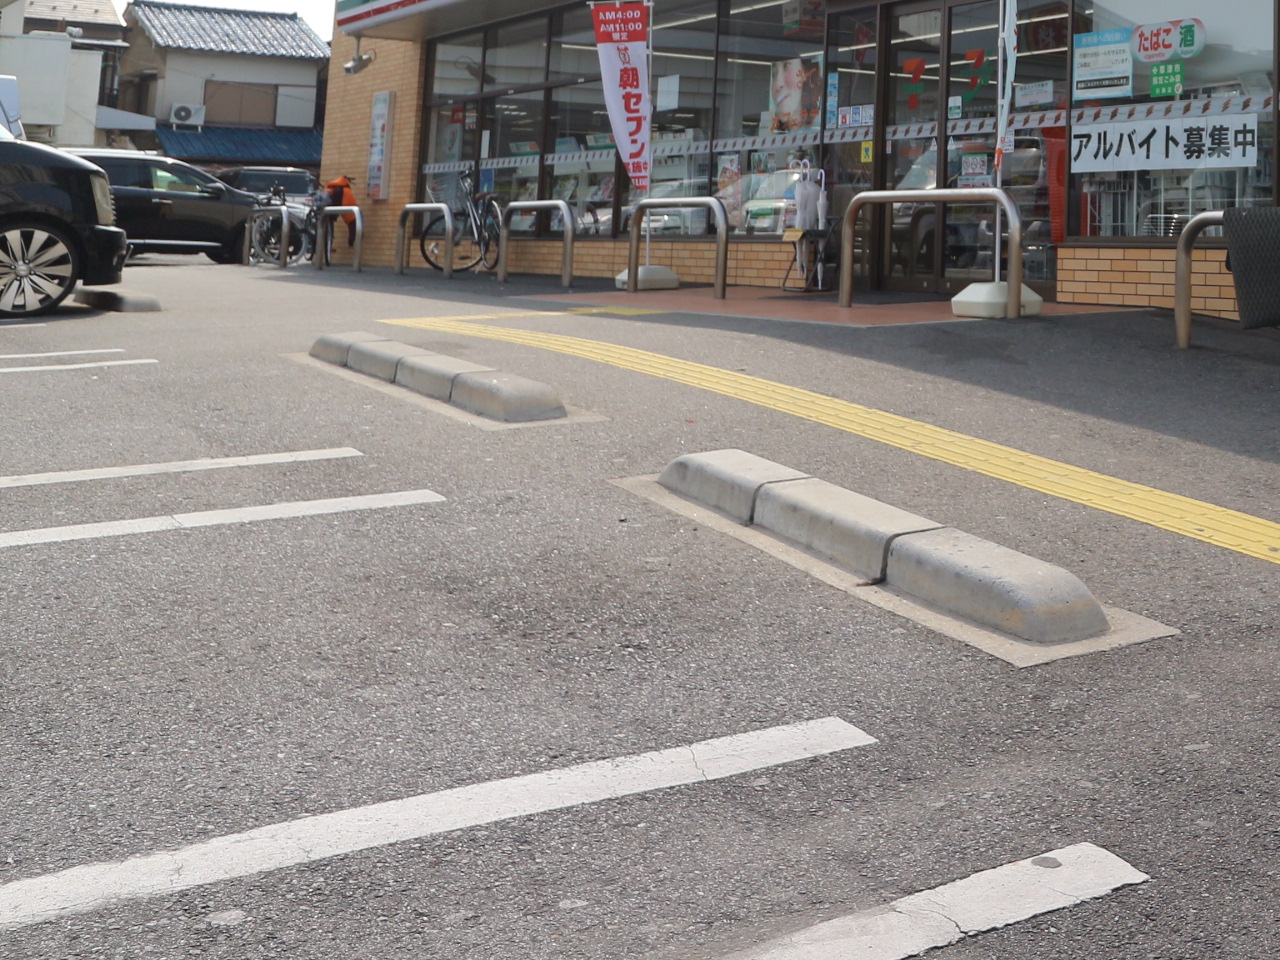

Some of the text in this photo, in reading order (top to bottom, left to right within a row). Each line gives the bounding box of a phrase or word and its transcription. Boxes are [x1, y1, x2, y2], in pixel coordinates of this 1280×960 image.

[599, 9, 641, 21] AM4:00
[600, 21, 643, 32] AM11:00
[1138, 24, 1195, 53] たばこ 酒
[618, 66, 647, 160] 朝セブン
[1073, 123, 1256, 162] アルバイト募集中
